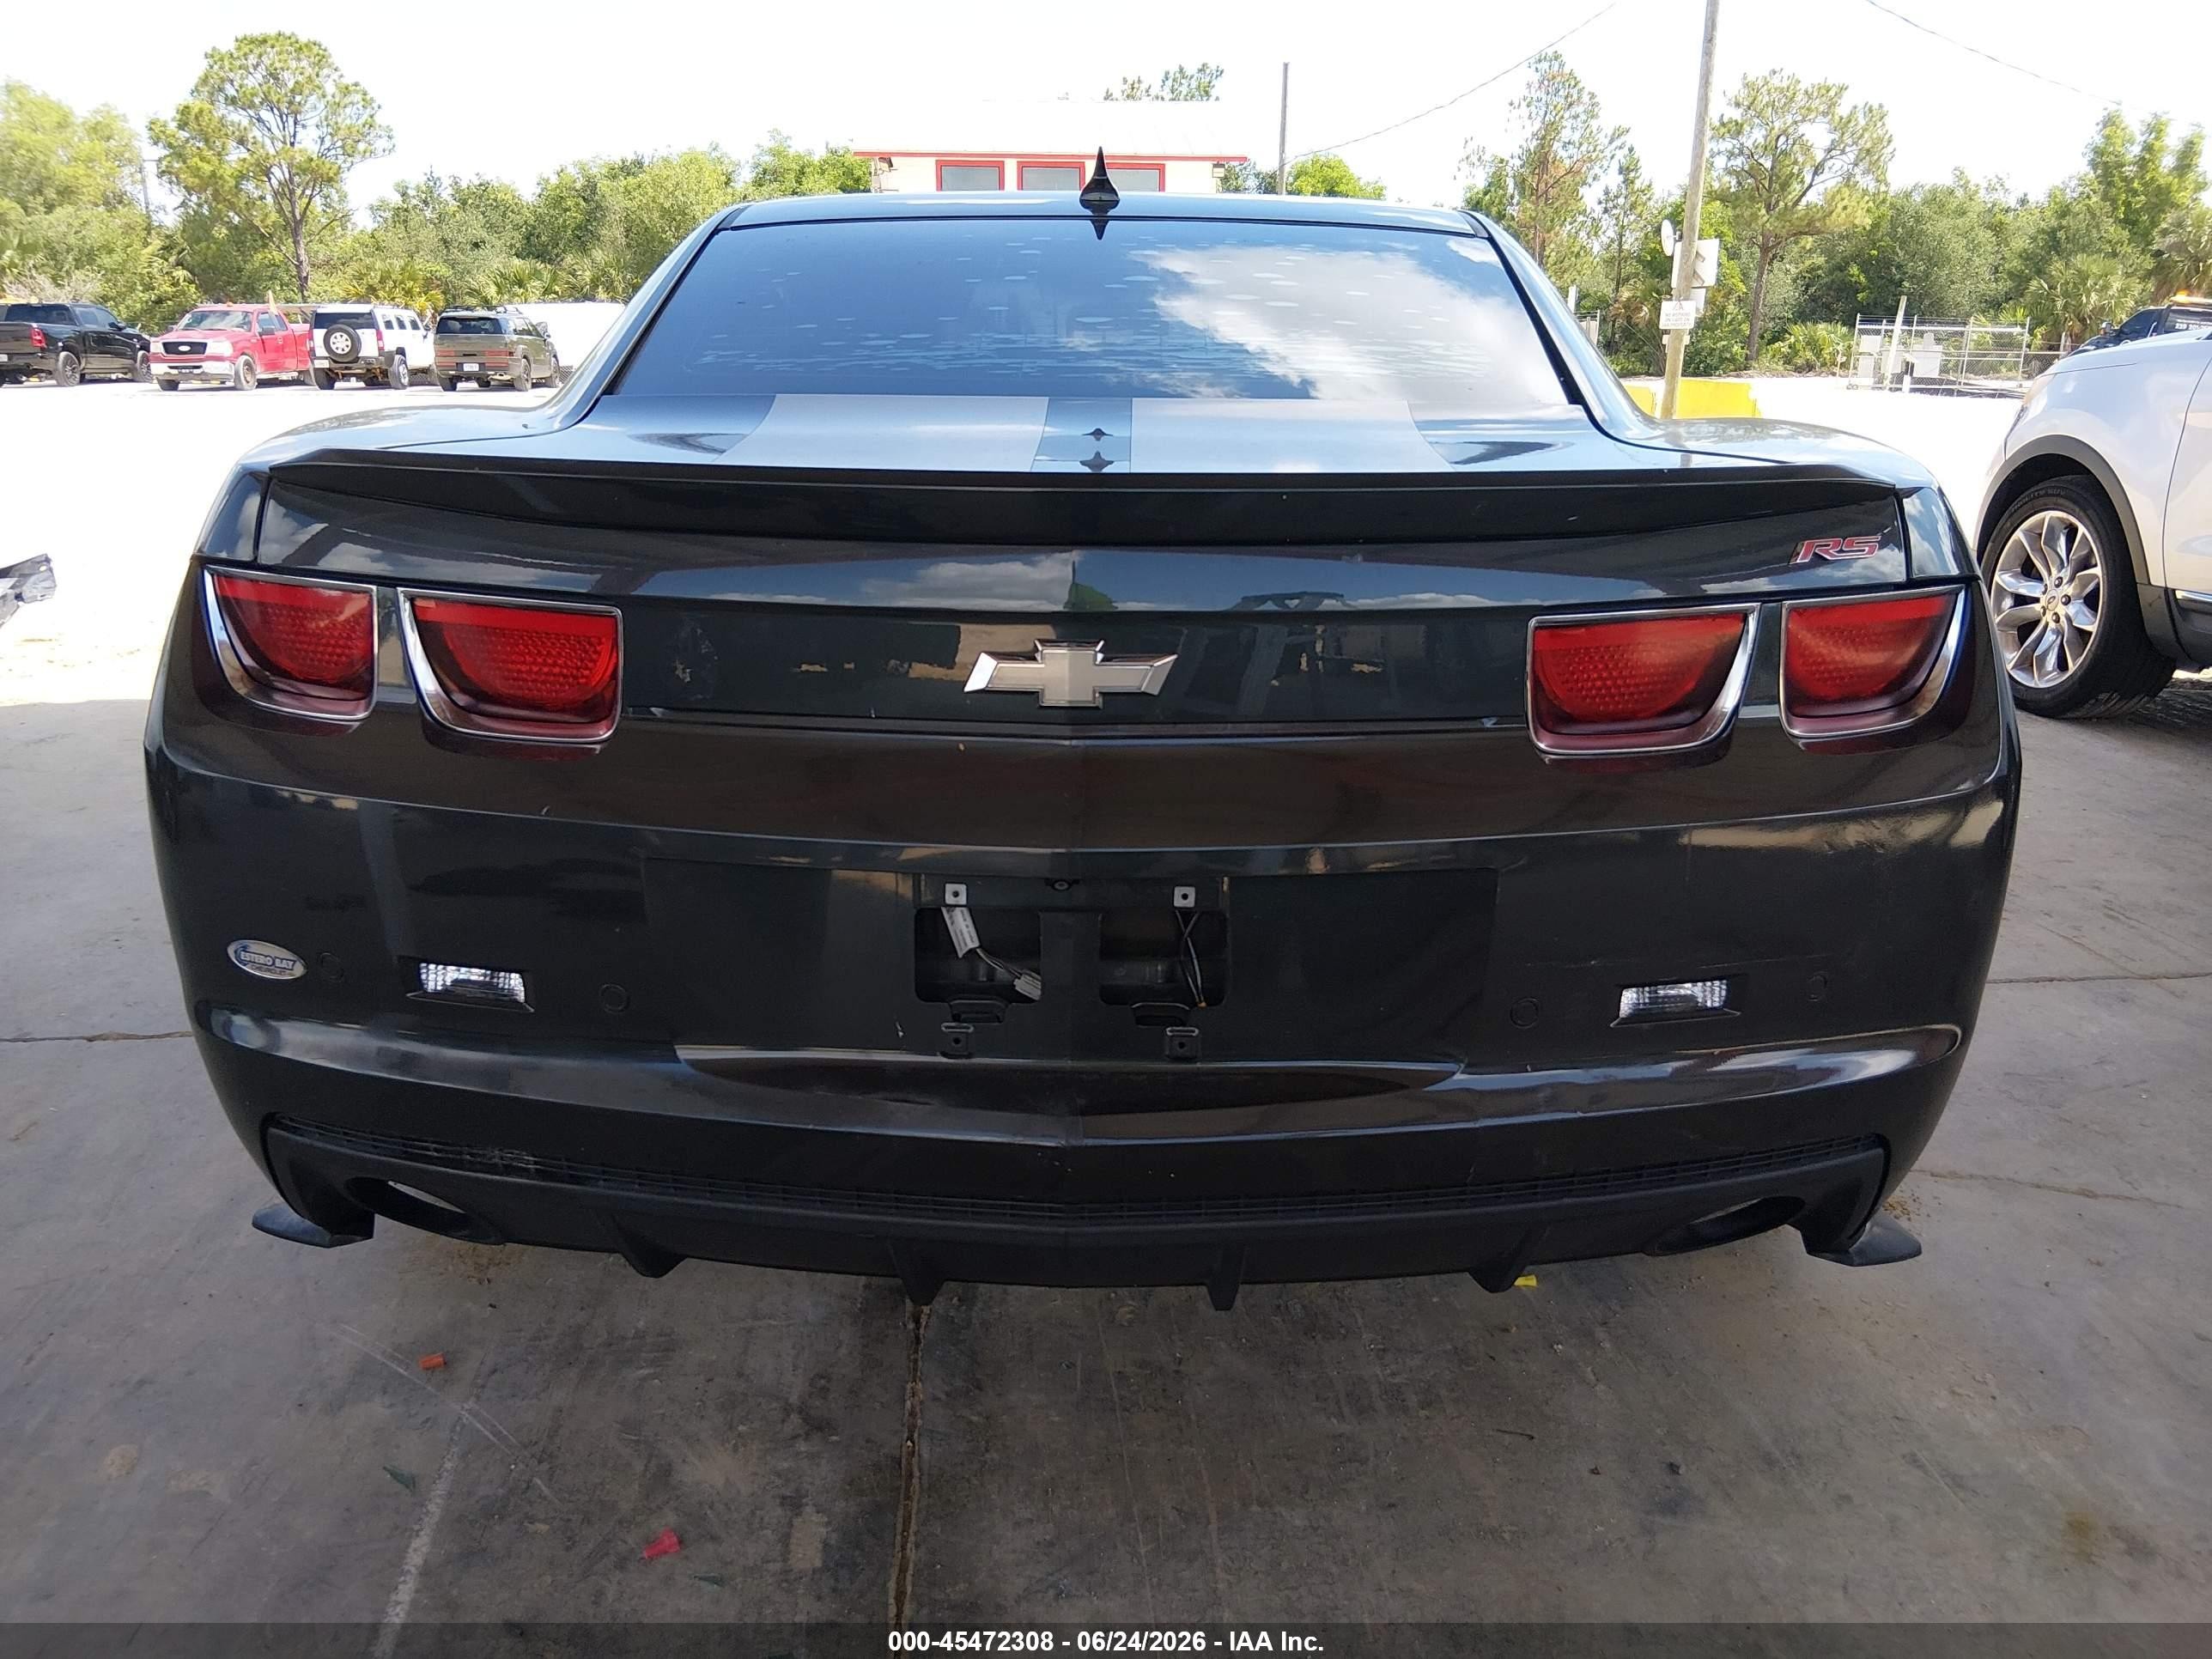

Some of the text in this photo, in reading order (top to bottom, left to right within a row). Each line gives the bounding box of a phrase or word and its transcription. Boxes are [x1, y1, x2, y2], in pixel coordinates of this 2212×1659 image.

[1791, 535, 1881, 563] RS
[240, 951, 295, 969] ESTERO BAY
